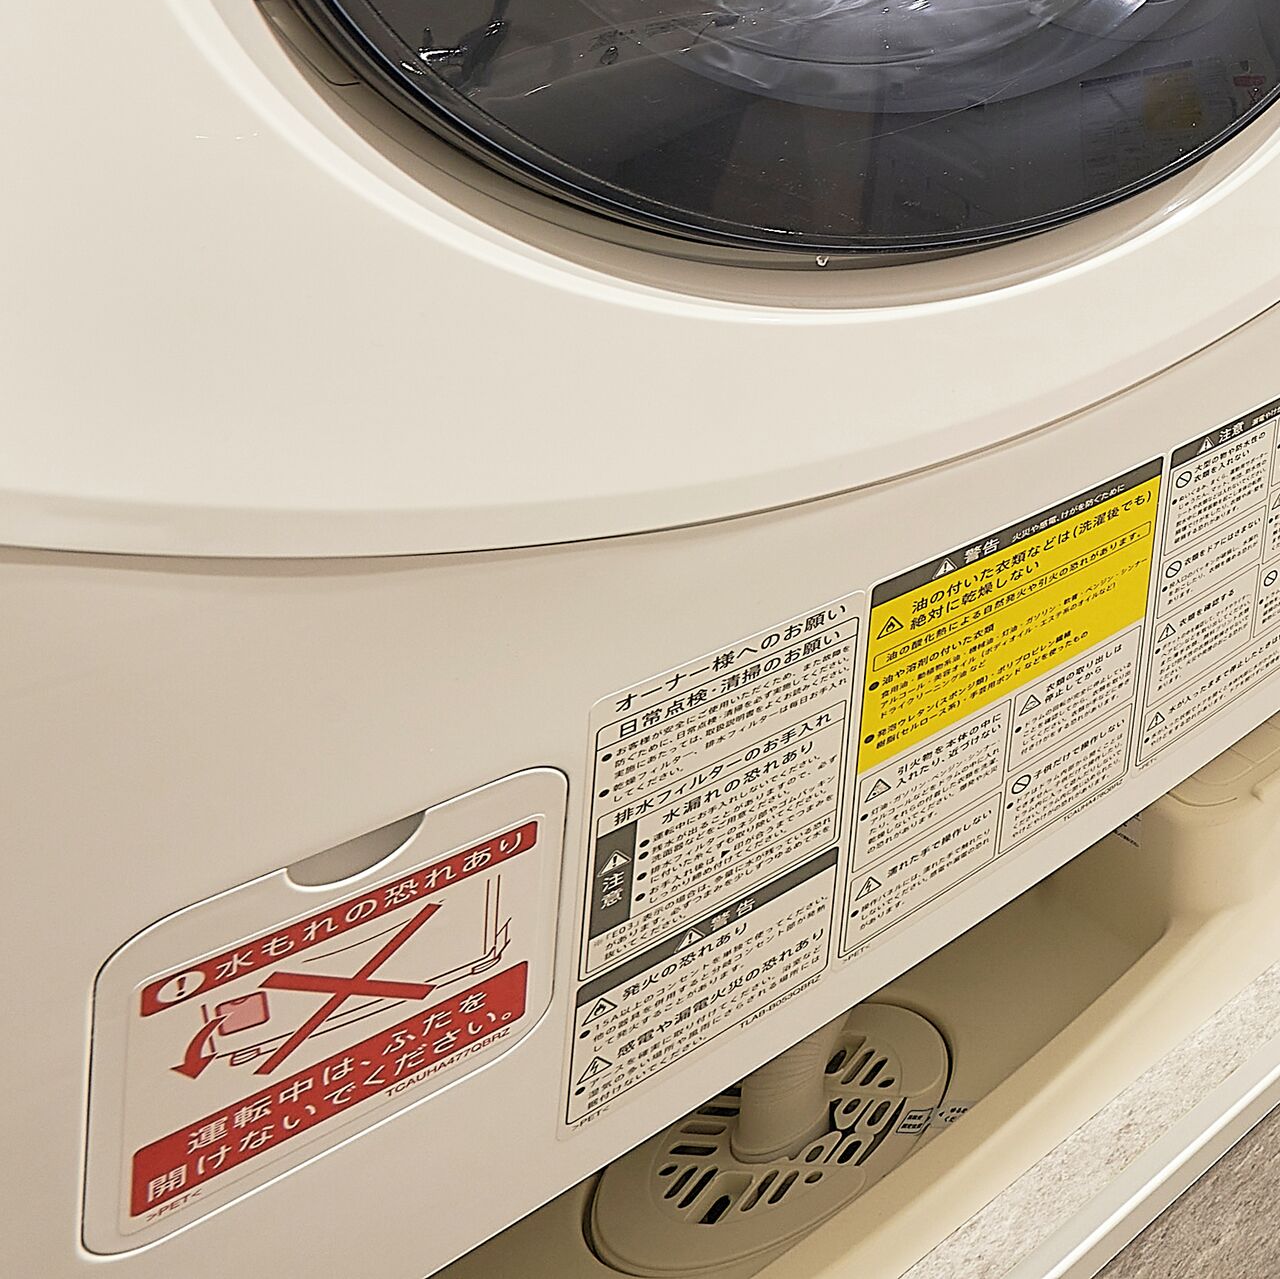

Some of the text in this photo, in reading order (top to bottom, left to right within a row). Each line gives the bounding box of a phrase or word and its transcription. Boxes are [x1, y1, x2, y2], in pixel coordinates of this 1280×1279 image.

[1218, 422, 1244, 443] 注意
[1193, 449, 1251, 483] 衣類を入れない
[964, 538, 1000, 565] 警告
[910, 561, 1040, 631] 絶対に乾燥しない
[1179, 589, 1235, 627] 衣類を確認する
[615, 604, 847, 714] オーナー様へのお願い
[619, 631, 840, 738] 日常点検・清掃のお願い
[882, 623, 995, 686] 油や溶剤の付いた衣類
[1044, 667, 1102, 704] 停止してから
[1045, 643, 1122, 694] 衣類の取り出しは
[613, 712, 832, 826] 排水フィルターのお手入れ
[896, 712, 1002, 777] 引火物を本体の中に
[896, 723, 1002, 789] 入れたり、近づけない
[1032, 718, 1126, 781] 子供だけで操作しない
[613, 766, 685, 803] してください。
[662, 741, 814, 824] 水漏れの恐れあり
[650, 788, 793, 864] 洗面器などをご用意ください。
[886, 808, 992, 880] 濡れた手で操作しない
[216, 831, 526, 982] 水もれの恐れあり
[601, 873, 624, 910] 注意
[710, 899, 756, 930] 警告
[617, 929, 825, 1058] 感電や漏電火災の恐れあり
[622, 923, 747, 1000] 発火の恐れあり
[146, 1008, 514, 1203] 開けないでください。
[187, 990, 489, 1155] 運転中は、ふたを
